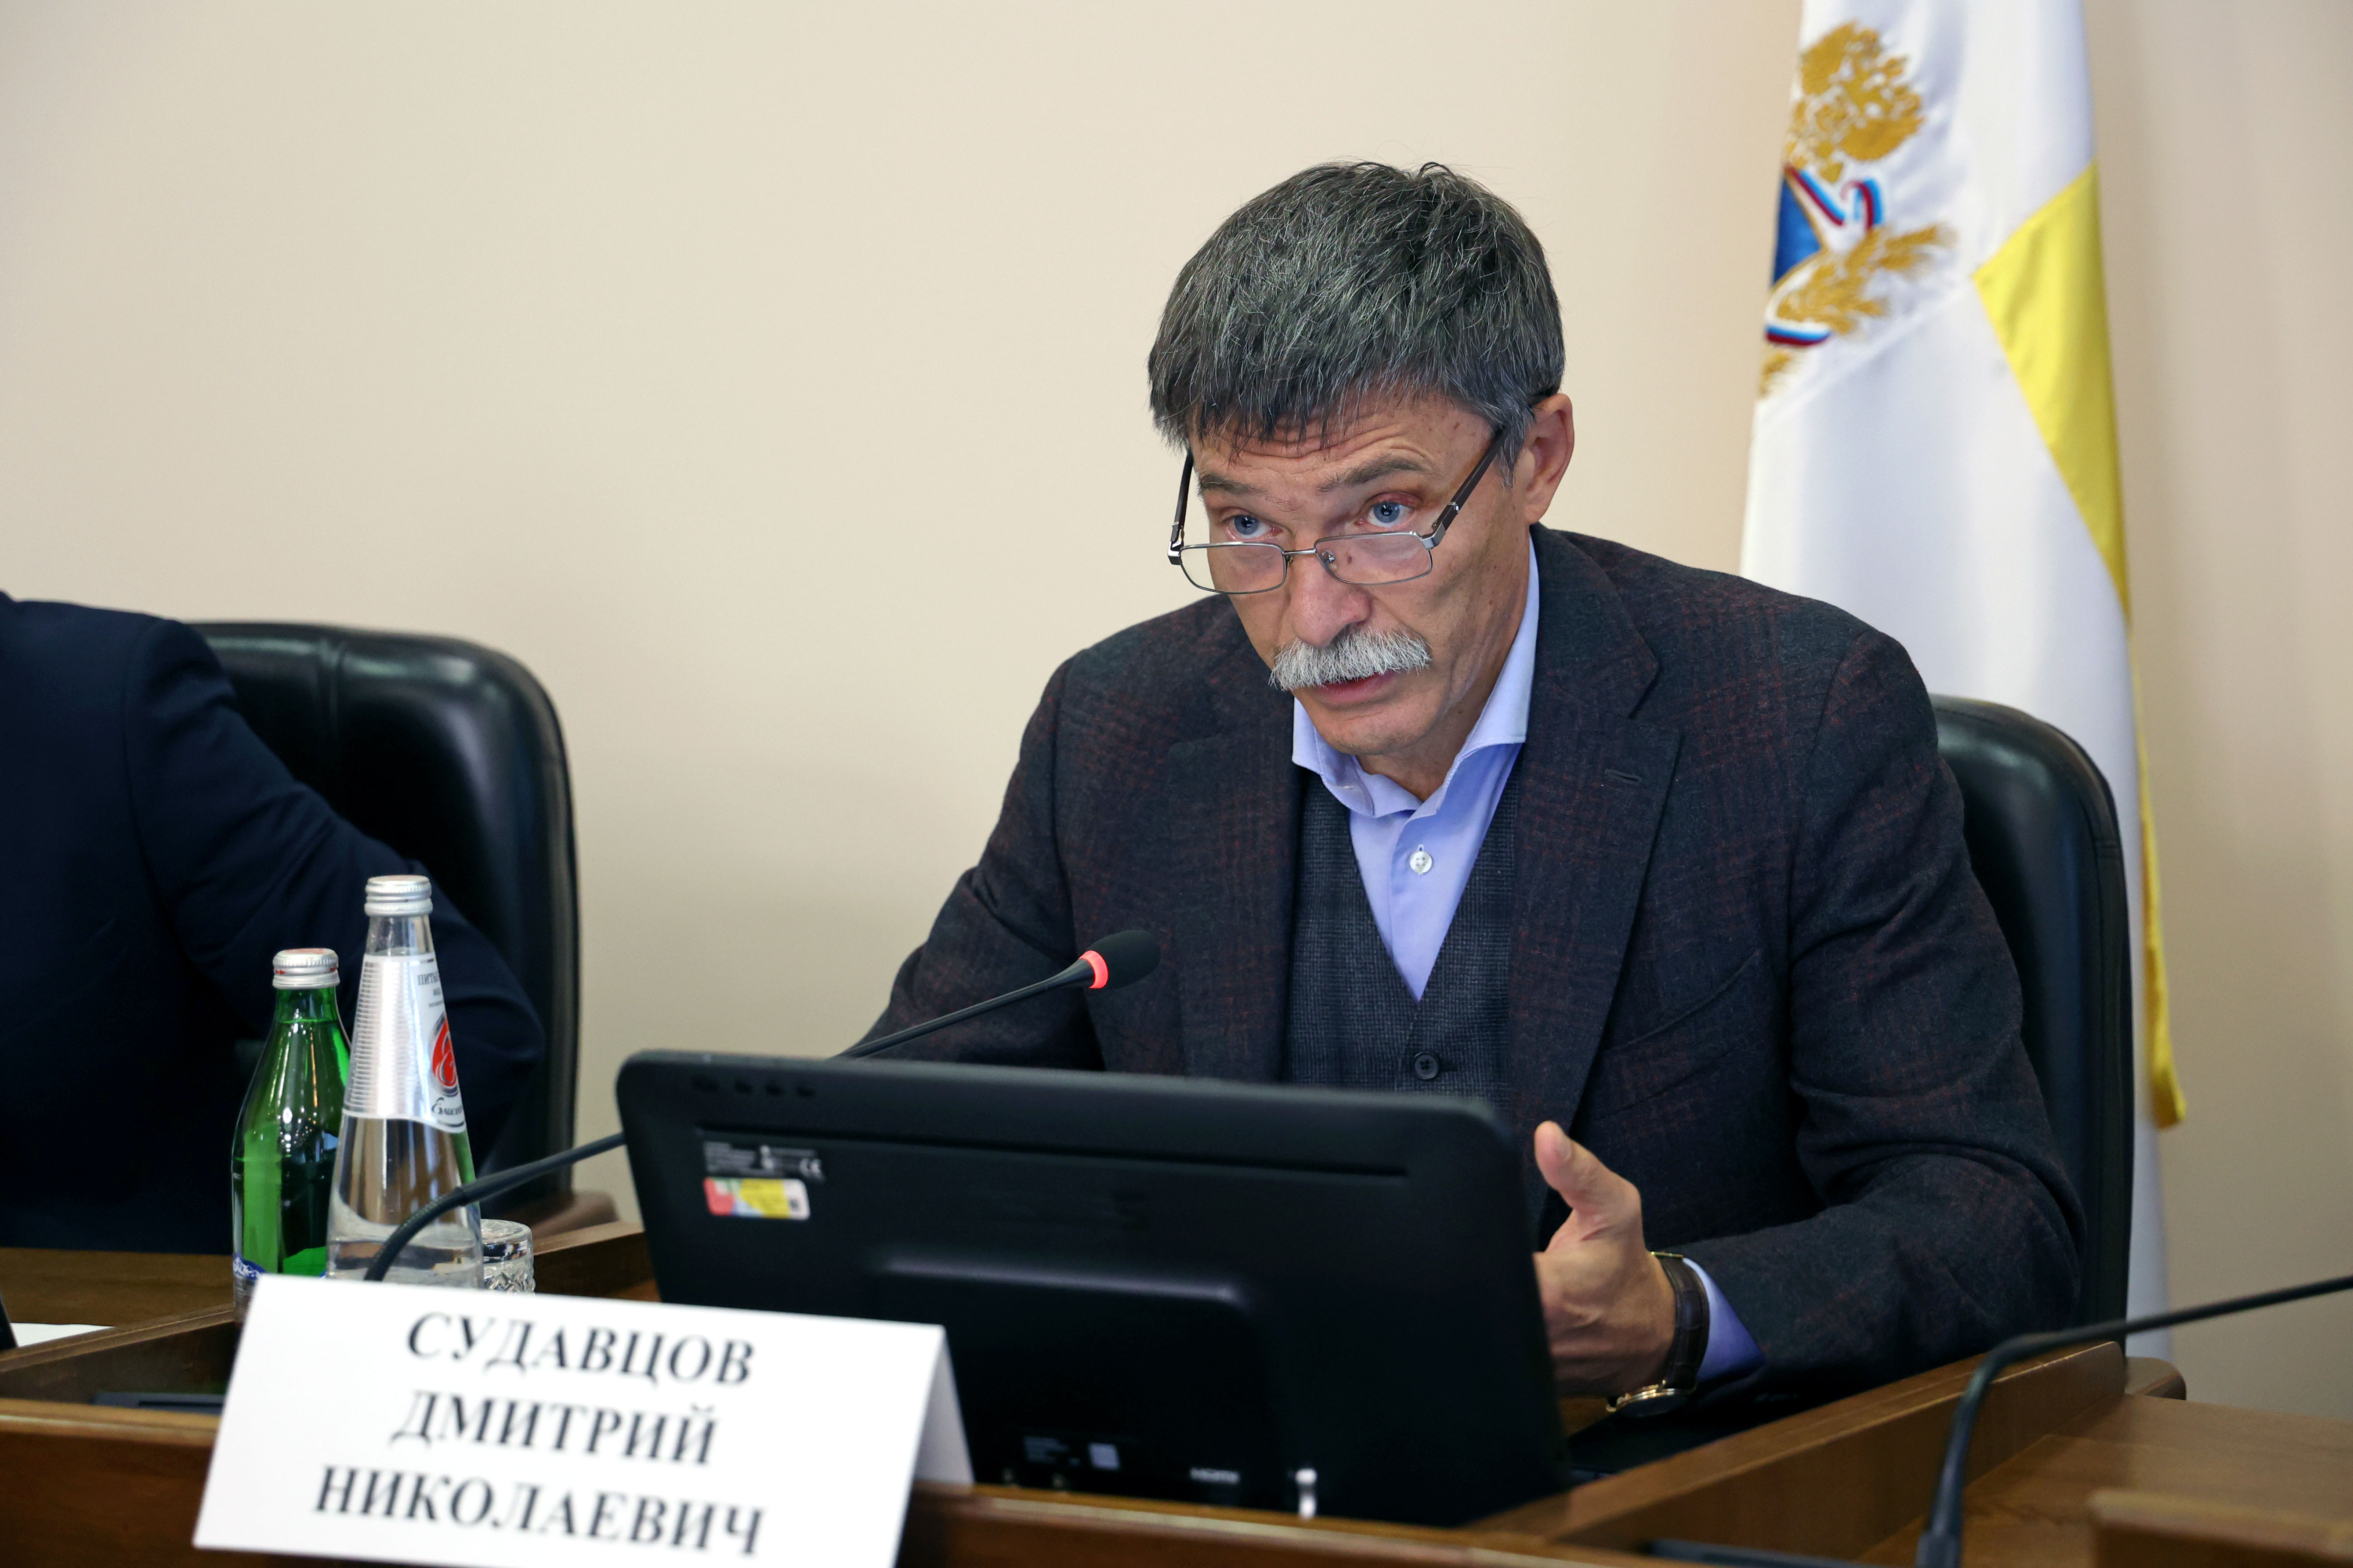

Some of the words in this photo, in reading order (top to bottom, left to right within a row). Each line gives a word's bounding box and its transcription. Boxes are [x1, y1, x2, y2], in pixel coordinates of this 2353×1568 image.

[407, 1313, 753, 1384] СУДАВЦОВ
[391, 1391, 717, 1465] ДМИТРИЙ
[314, 1465, 763, 1555] НИКОЛАЕВИЧ
